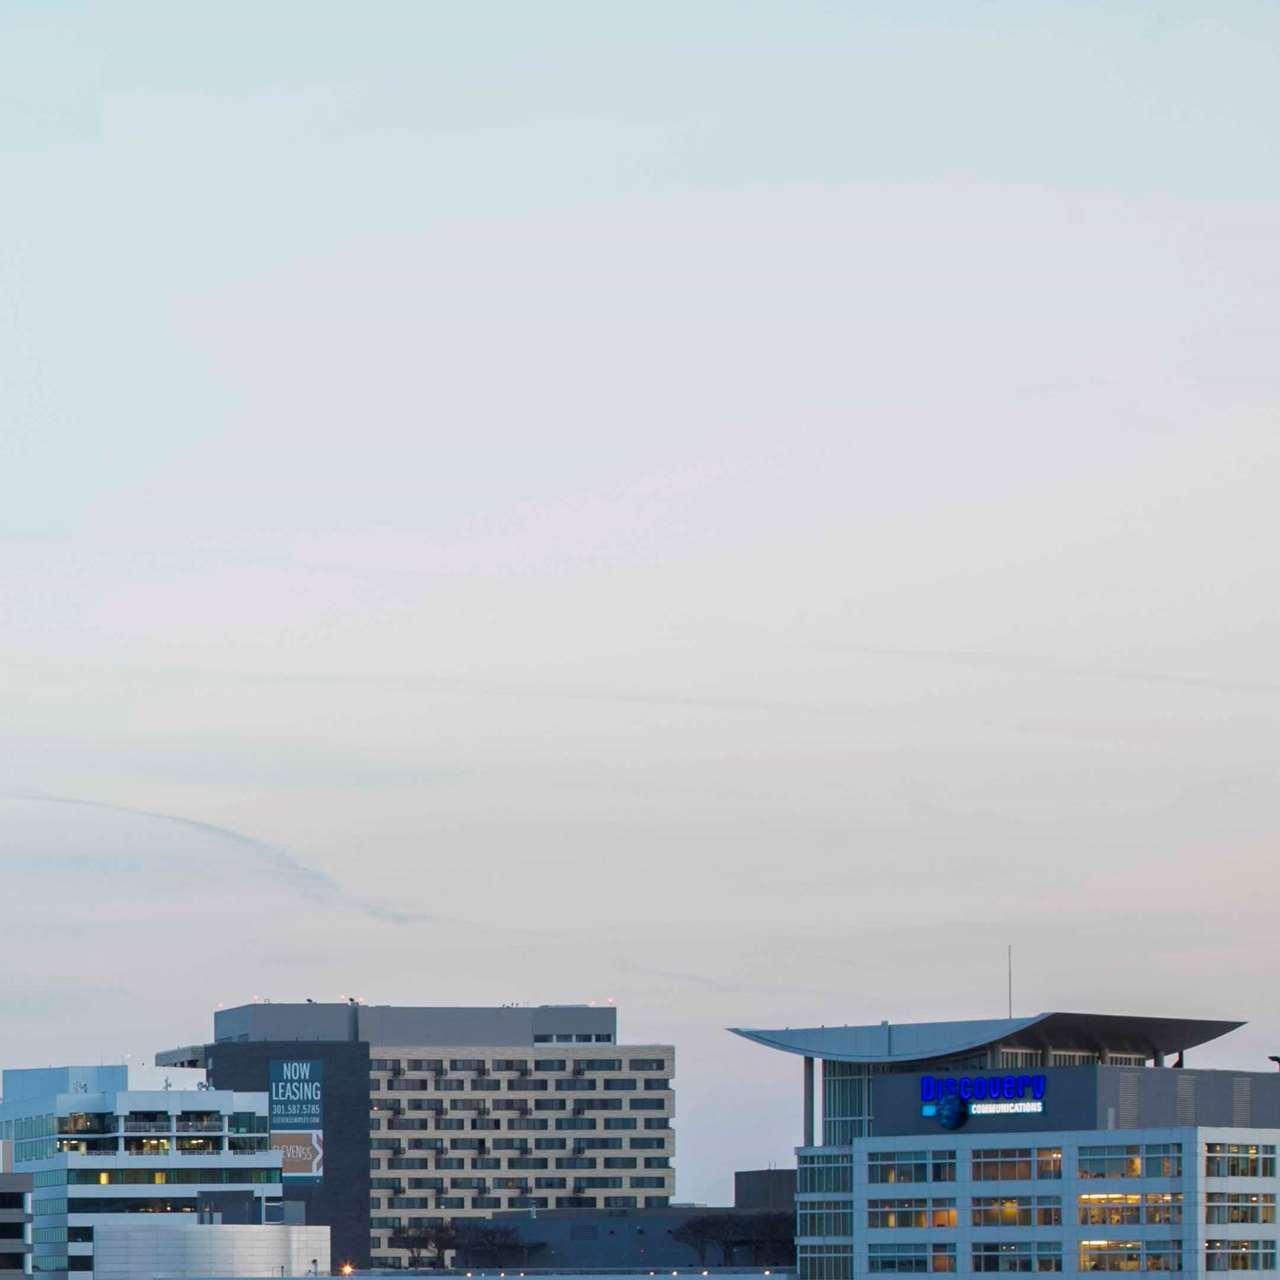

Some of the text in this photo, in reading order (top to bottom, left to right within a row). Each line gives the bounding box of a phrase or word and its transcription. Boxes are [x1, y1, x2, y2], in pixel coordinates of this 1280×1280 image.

[283, 1062, 311, 1080] NOW
[272, 1082, 321, 1100] LEASING
[272, 1104, 320, 1115] 301.587.5785
[971, 1102, 1042, 1114] COMMUNICATIONS
